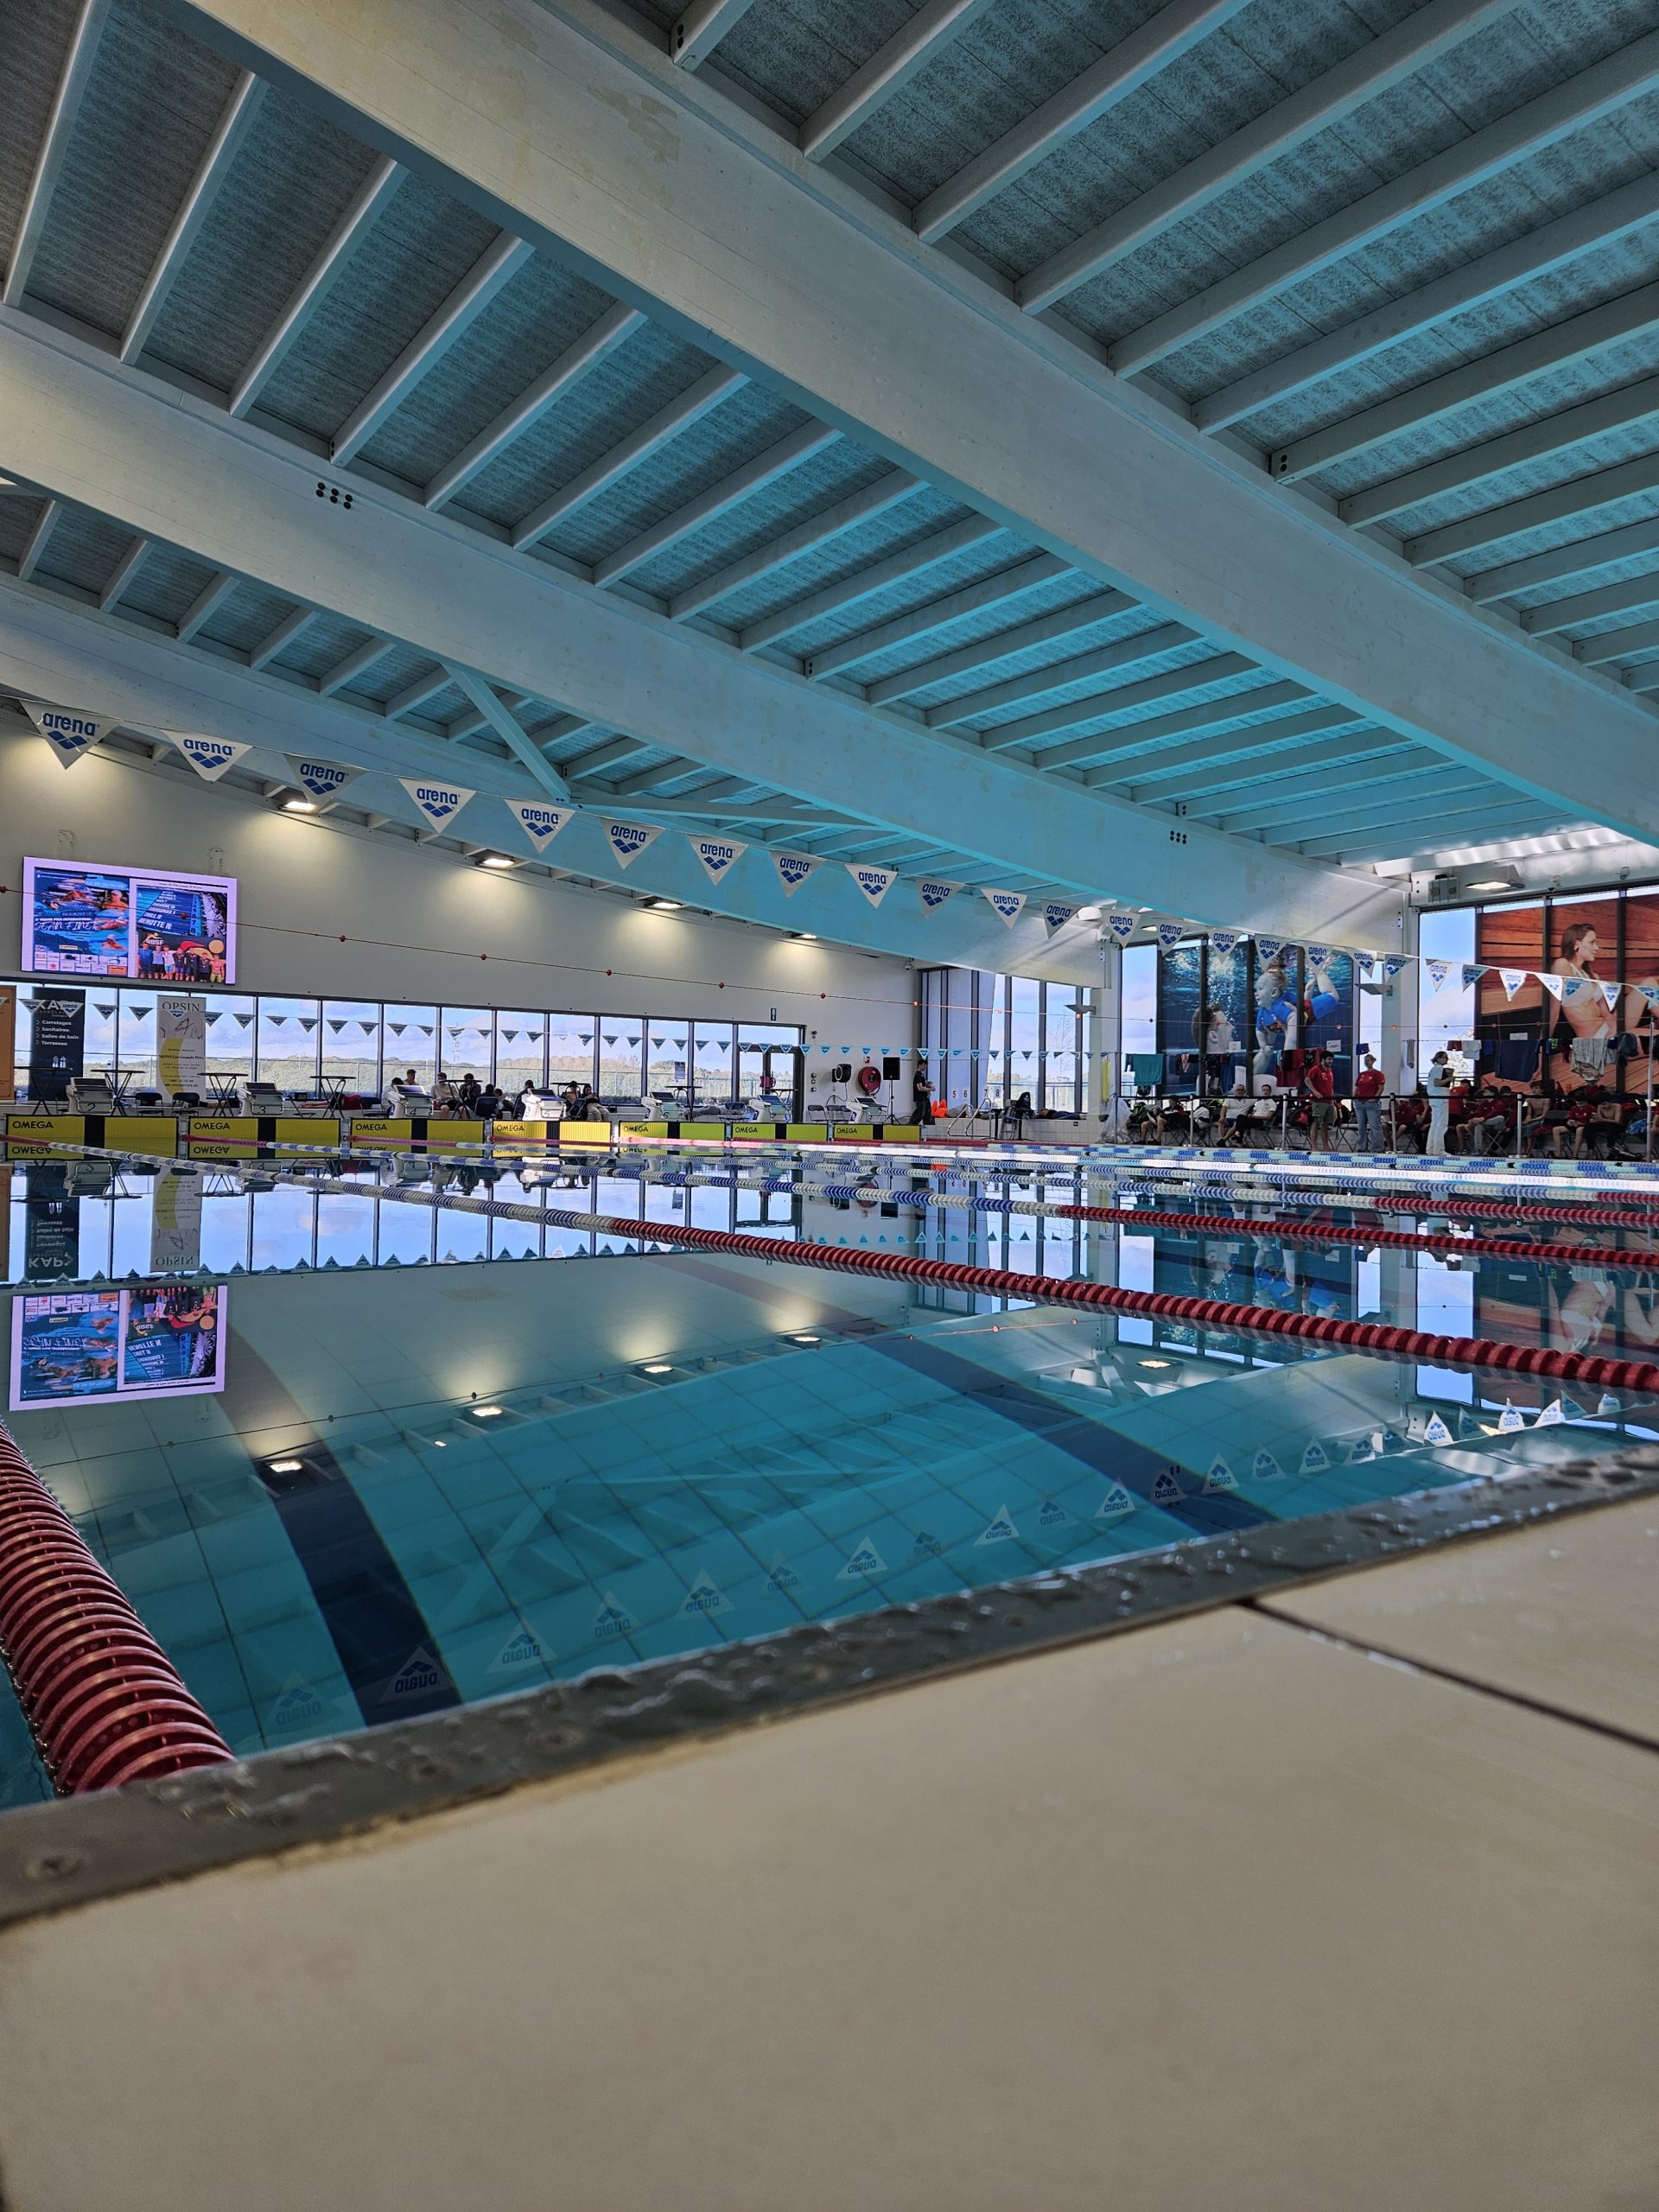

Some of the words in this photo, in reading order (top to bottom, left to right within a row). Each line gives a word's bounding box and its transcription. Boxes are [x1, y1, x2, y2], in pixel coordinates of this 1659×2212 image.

[42, 712, 96, 736] arena
[183, 739, 232, 756] arena
[300, 762, 346, 783] arena
[416, 787, 459, 804] arena
[521, 806, 559, 824] arena
[611, 824, 646, 842] arena
[700, 842, 733, 859] arena
[779, 857, 810, 873] arena
[859, 871, 887, 884] arena
[922, 883, 950, 897] arena
[993, 894, 1019, 906] arena
[1046, 904, 1071, 918] arena
[1109, 915, 1133, 926] arena
[1160, 924, 1182, 936] arena
[1213, 931, 1234, 944] arena
[1259, 939, 1280, 950] arena
[1308, 946, 1326, 956] arena
[1387, 957, 1406, 967] arena
[1430, 964, 1447, 973] arena
[162, 1001, 200, 1012] OPSIN
[87, 1103, 96, 1112] 2
[13, 1121, 54, 1129] OMEGA
